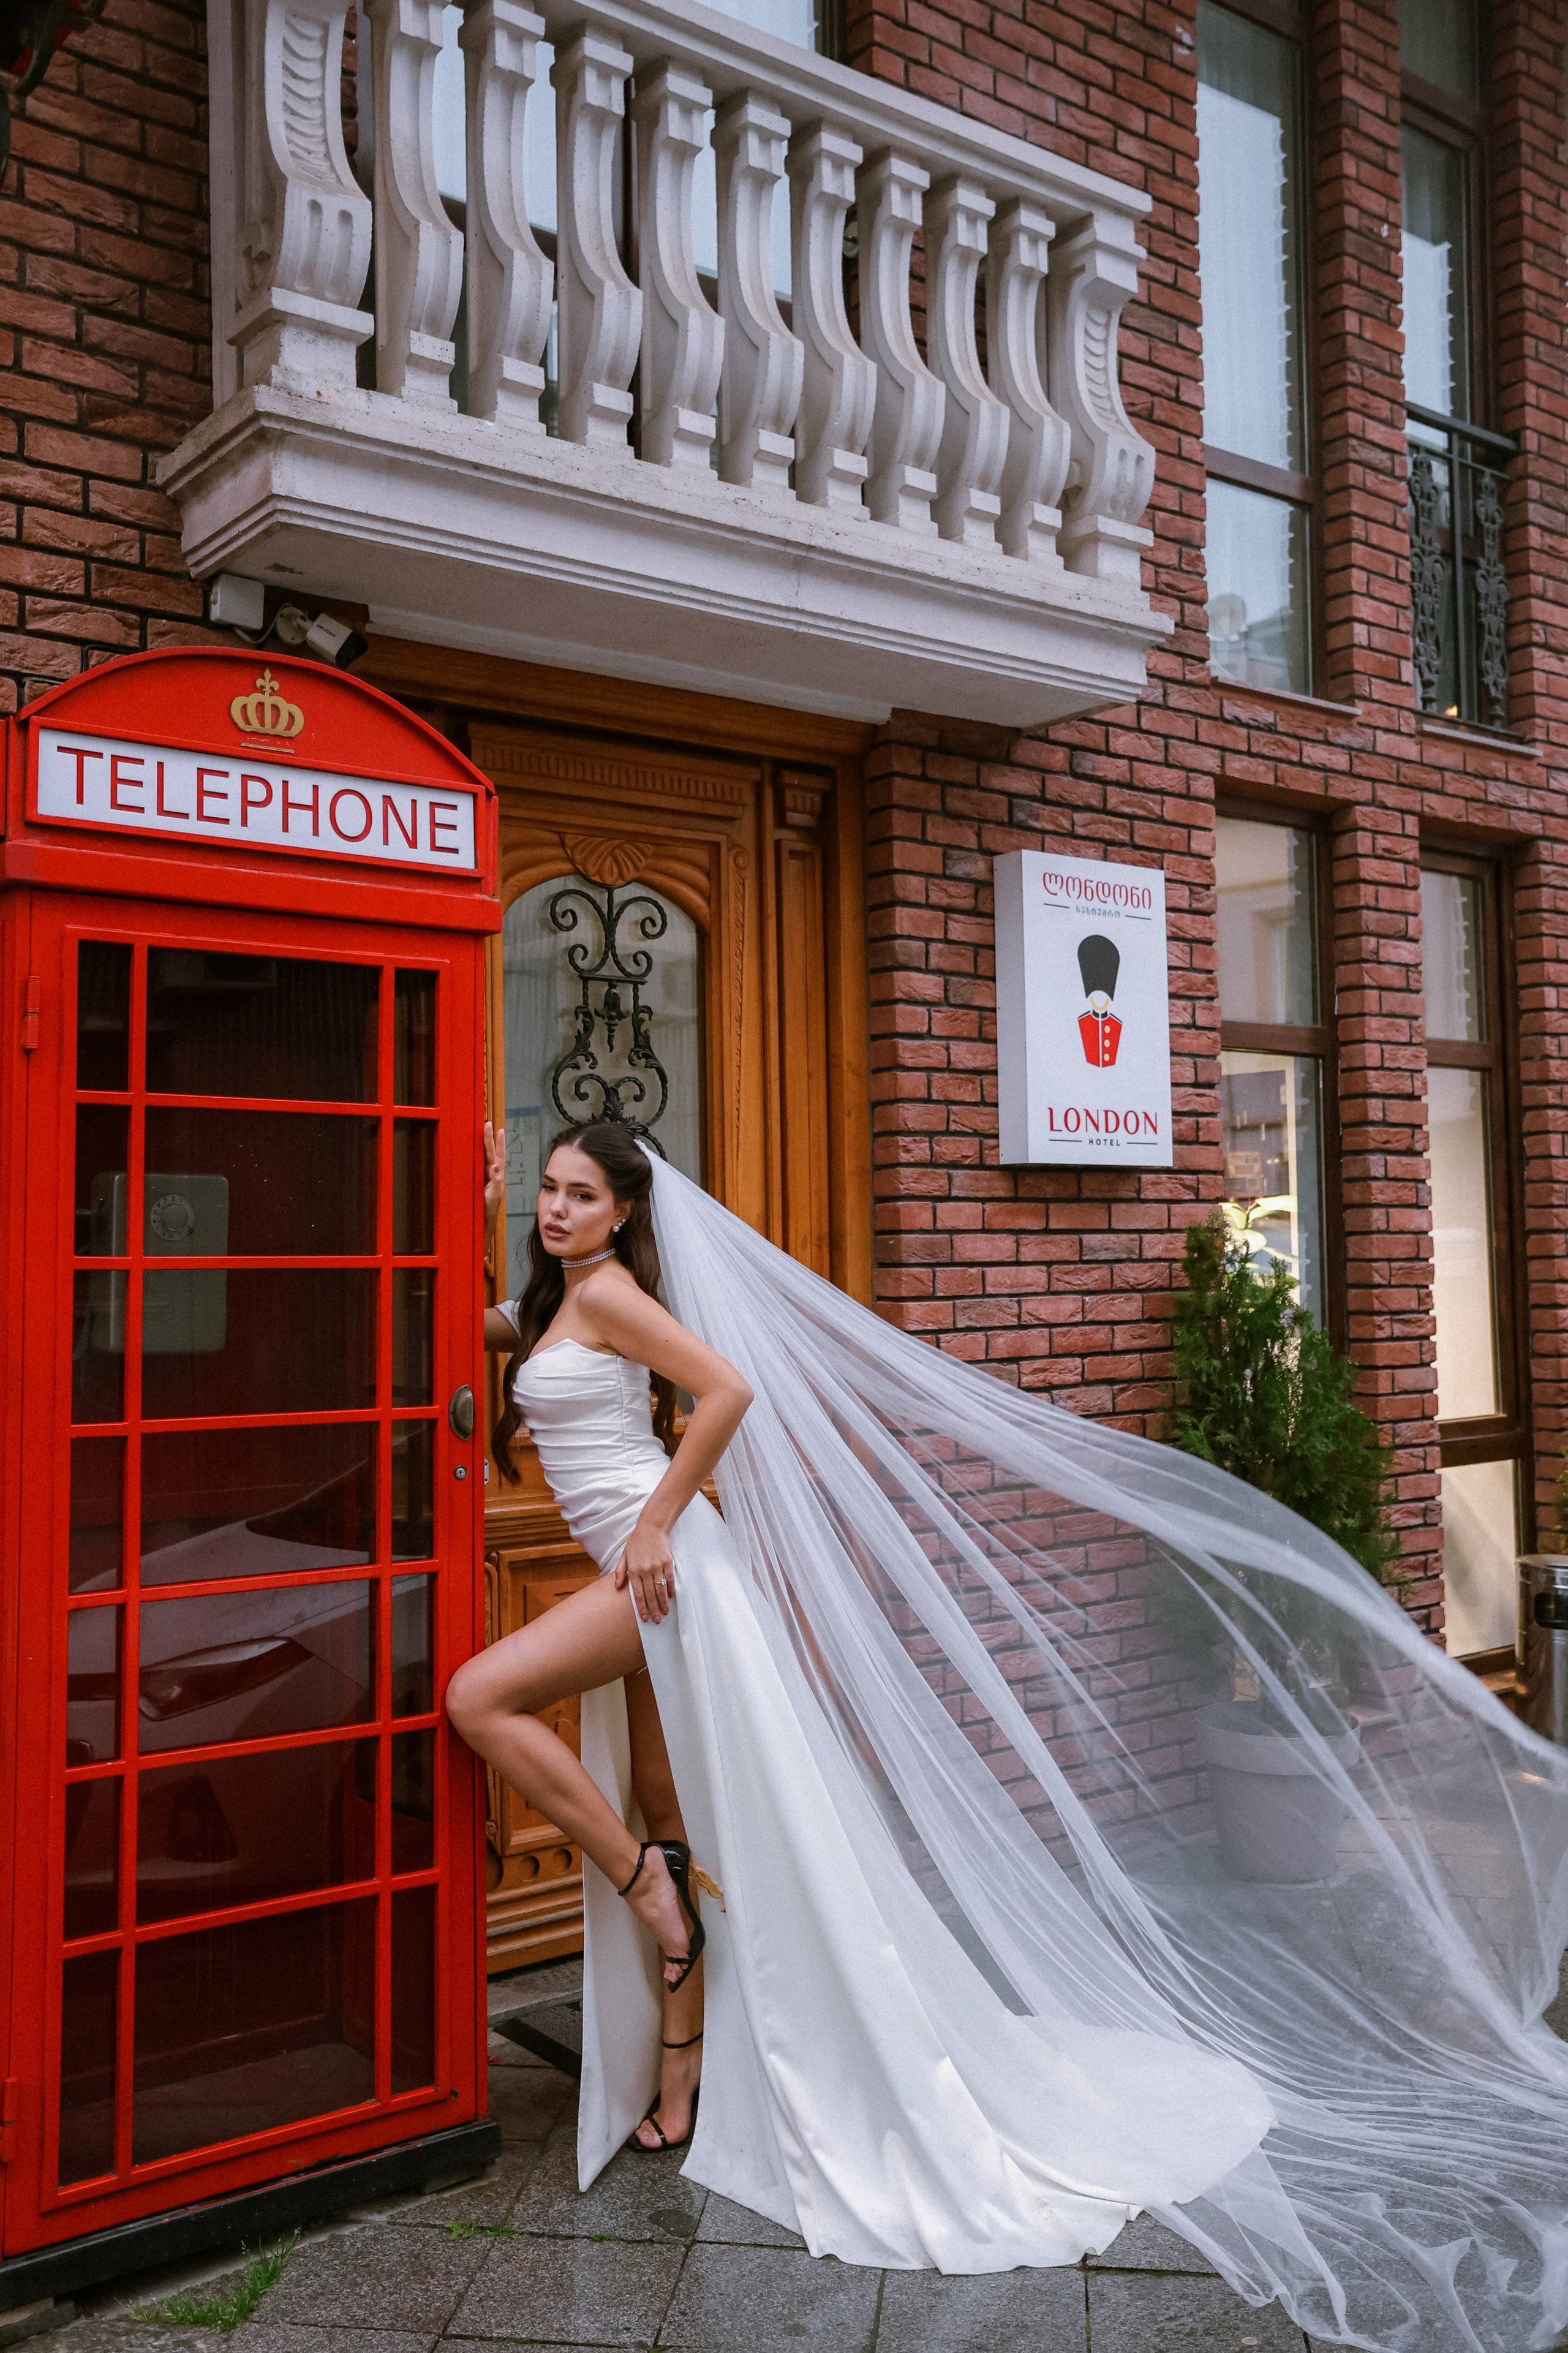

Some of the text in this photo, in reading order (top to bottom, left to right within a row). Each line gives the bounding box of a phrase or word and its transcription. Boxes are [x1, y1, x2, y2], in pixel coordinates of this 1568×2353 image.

[57, 746, 459, 854] TELEPHONE
[1043, 872, 1152, 910] ლონდონი
[1076, 905, 1121, 919] სასტუმრო
[1047, 1107, 1158, 1135] LONDON
